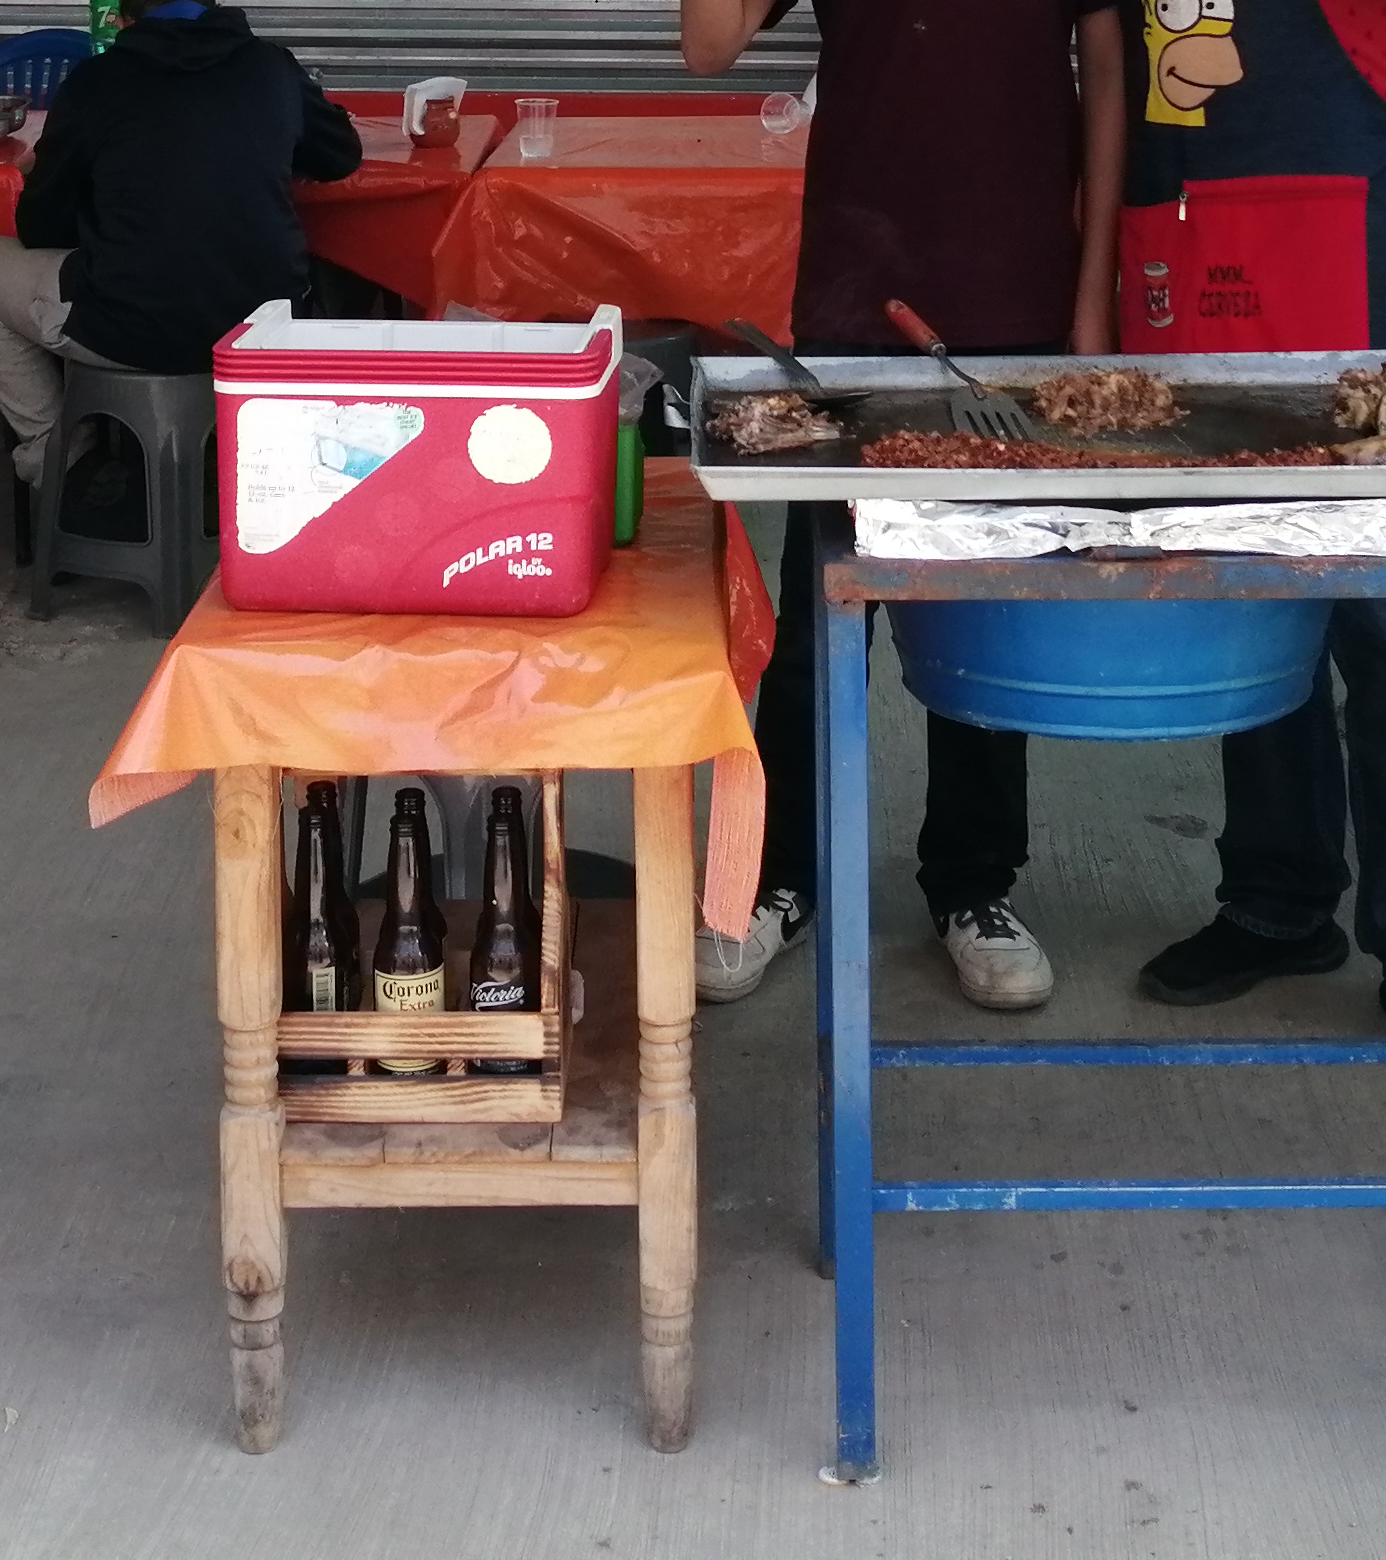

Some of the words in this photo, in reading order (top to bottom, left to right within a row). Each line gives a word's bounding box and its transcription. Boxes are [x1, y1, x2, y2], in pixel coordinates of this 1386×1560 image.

[443, 536, 522, 588] POLAR
[526, 533, 553, 550] 12
[383, 979, 439, 1002] Corona
[471, 980, 525, 1009] Victoria
[400, 999, 435, 1012] Extra
